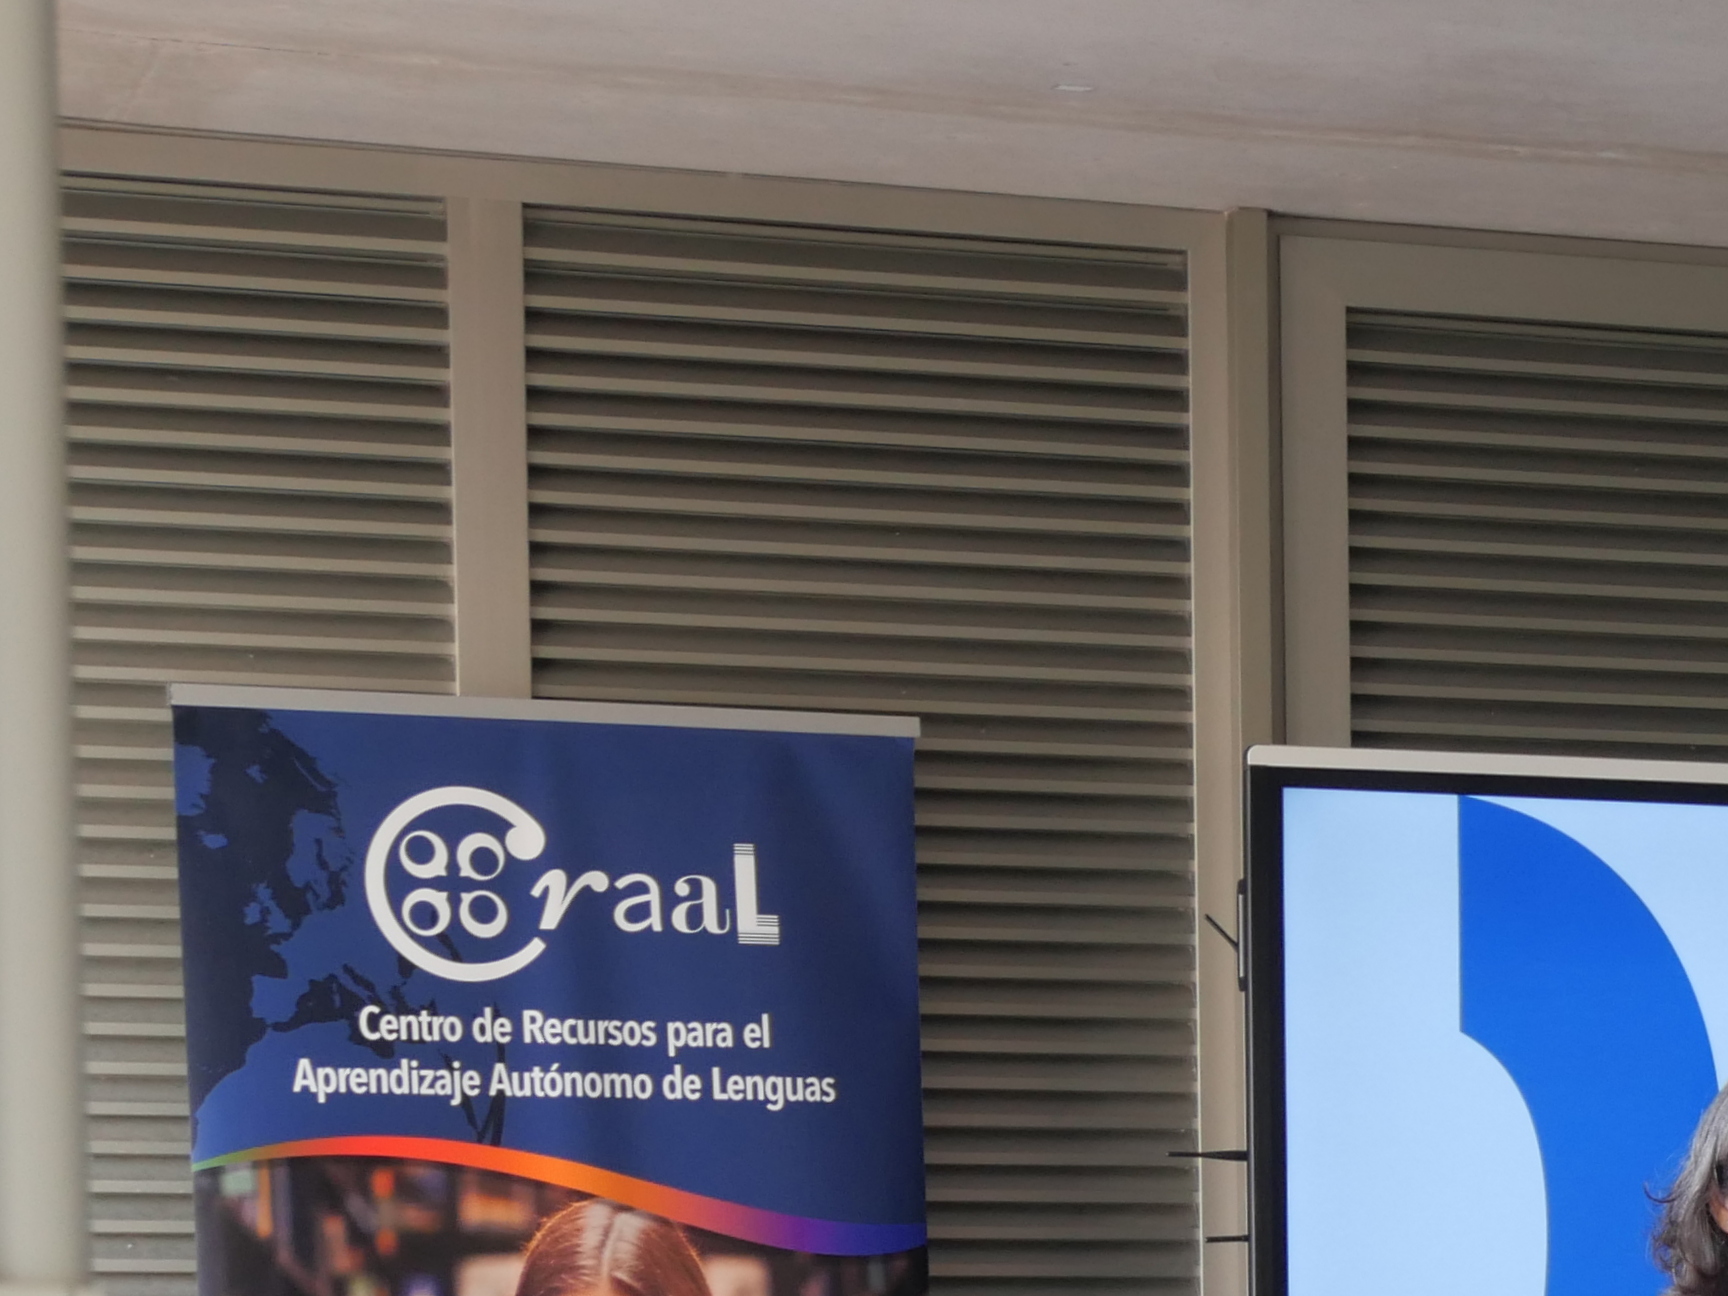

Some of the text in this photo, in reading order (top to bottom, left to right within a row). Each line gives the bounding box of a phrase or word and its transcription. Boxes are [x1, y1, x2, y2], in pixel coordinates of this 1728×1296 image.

[357, 1005, 771, 1057] Centro de Recursos para el
[293, 1058, 836, 1111] Aprendizaje Autónomo de Lenguas
